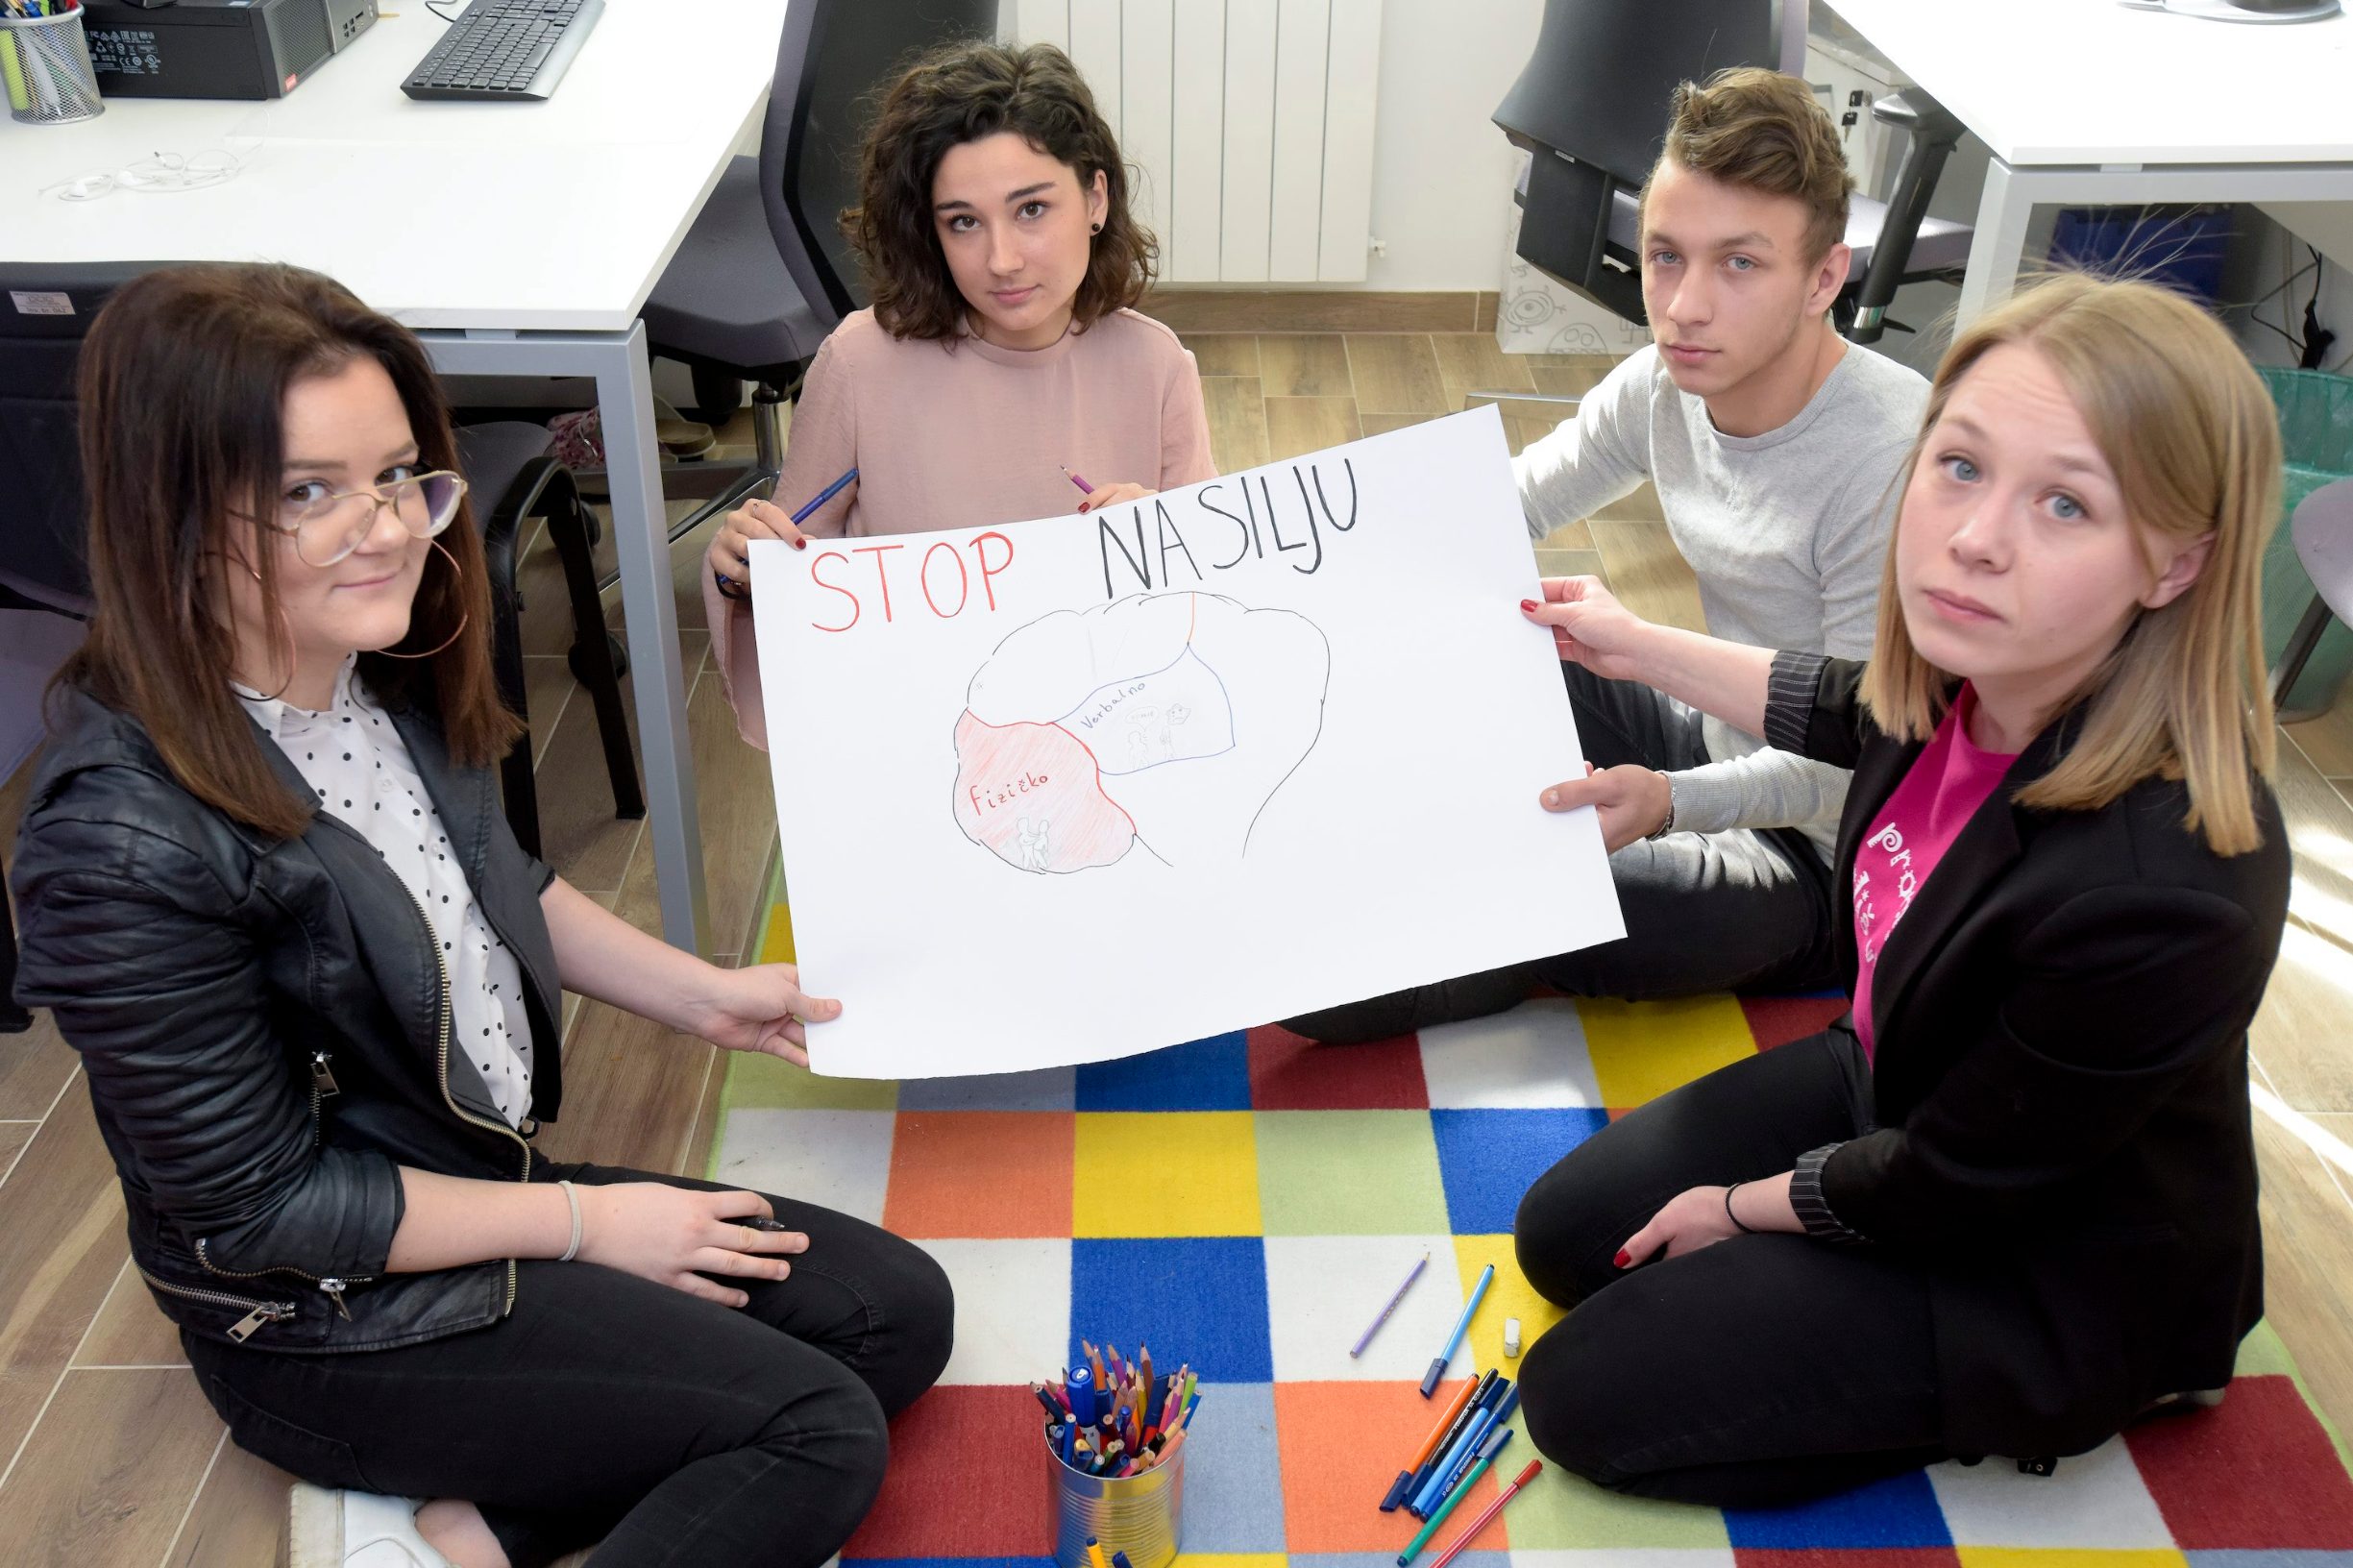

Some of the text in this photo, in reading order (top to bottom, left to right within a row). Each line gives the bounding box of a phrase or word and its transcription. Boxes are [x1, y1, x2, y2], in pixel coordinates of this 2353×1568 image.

[811, 457, 1357, 634] STOP NASILJU
[1080, 683, 1145, 729] Verbalno
